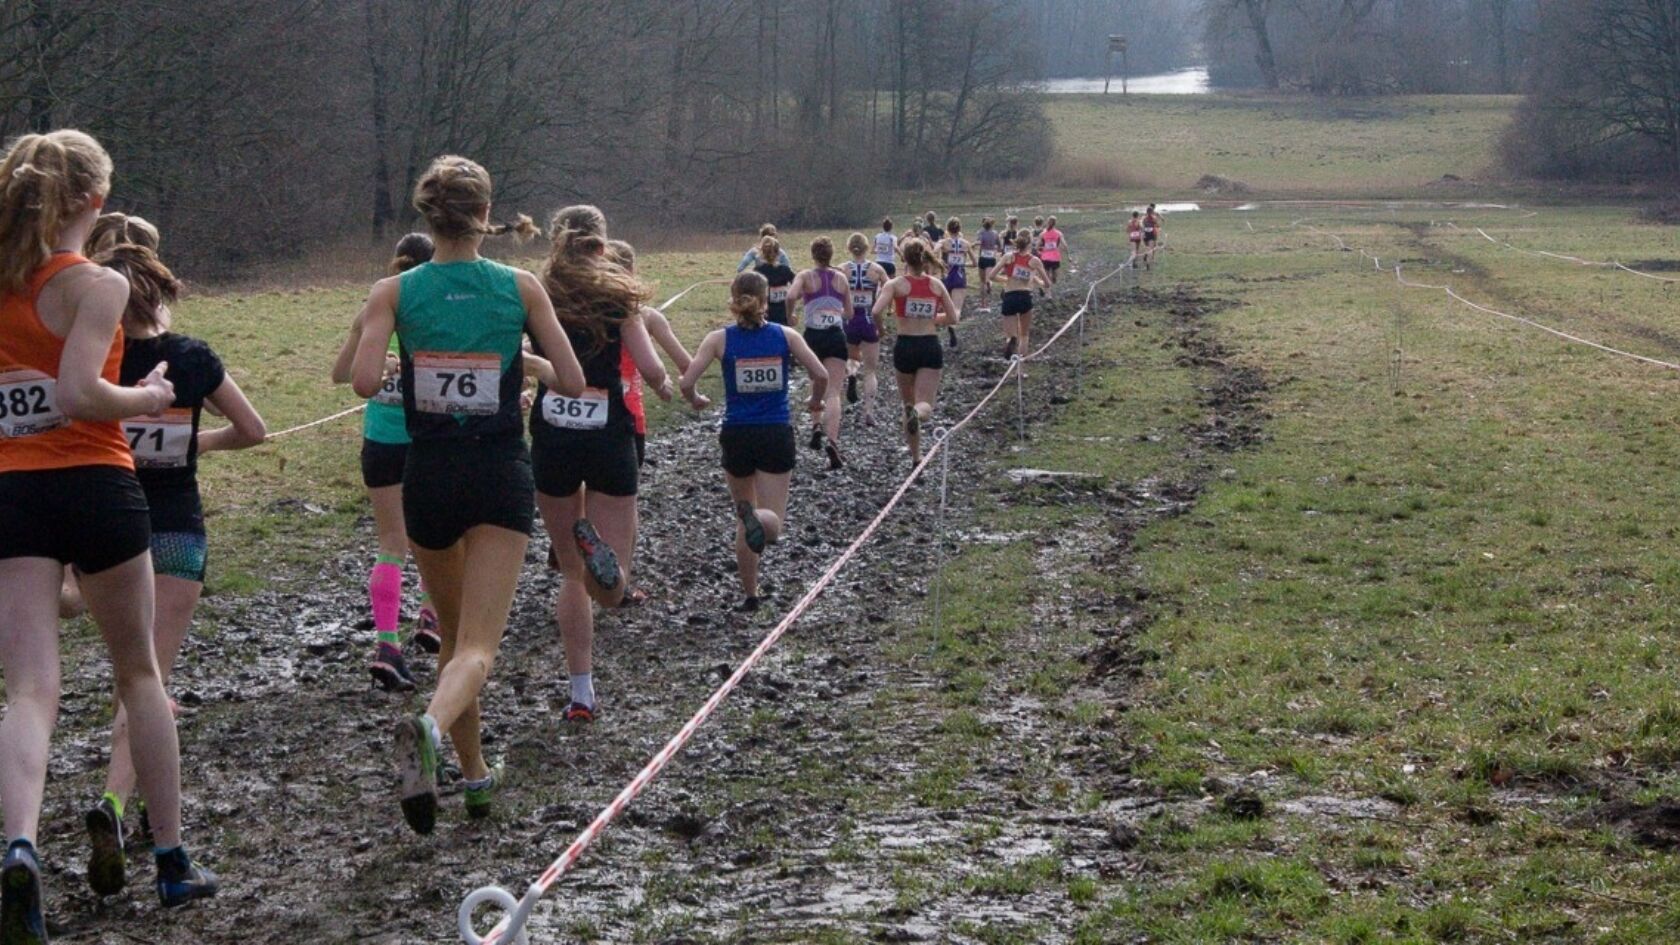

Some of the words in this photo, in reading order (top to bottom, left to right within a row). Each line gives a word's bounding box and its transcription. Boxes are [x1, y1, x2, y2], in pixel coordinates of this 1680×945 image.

[910, 302, 932, 313] 373
[820, 315, 835, 324] 70
[742, 368, 777, 383] 380
[436, 373, 477, 397] 76
[551, 397, 599, 418] 367
[126, 427, 164, 452] 71
